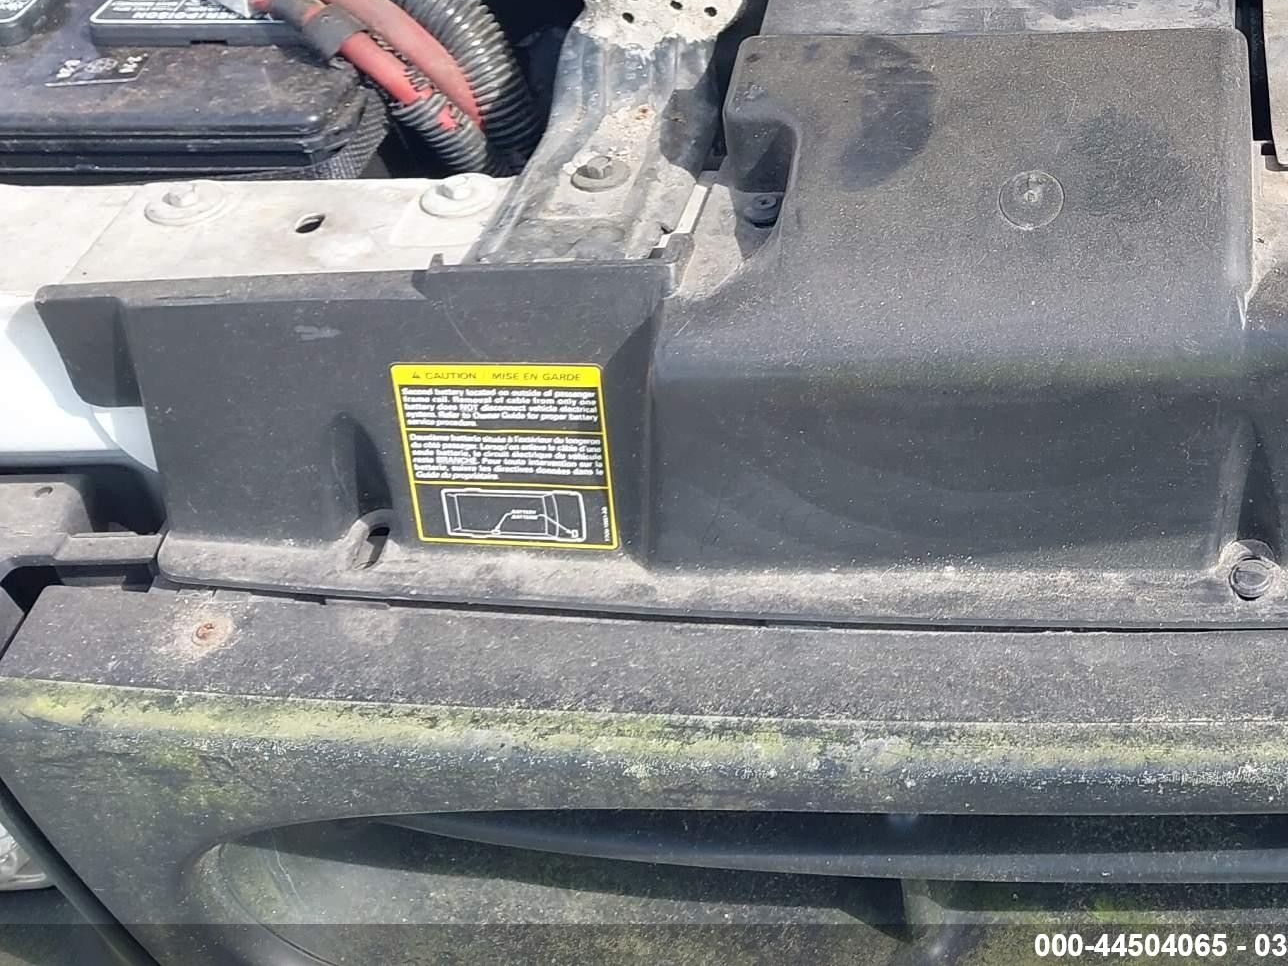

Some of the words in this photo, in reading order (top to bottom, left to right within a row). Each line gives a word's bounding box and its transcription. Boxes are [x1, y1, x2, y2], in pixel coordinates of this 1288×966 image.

[425, 372, 477, 380] CAUTION
[492, 372, 518, 380] MISE
[434, 388, 464, 396] battery
[466, 388, 496, 396] located
[494, 396, 504, 404] of
[556, 398, 577, 406] only
[480, 404, 526, 412] disconnect
[526, 412, 540, 420] for
[568, 414, 598, 422] battery
